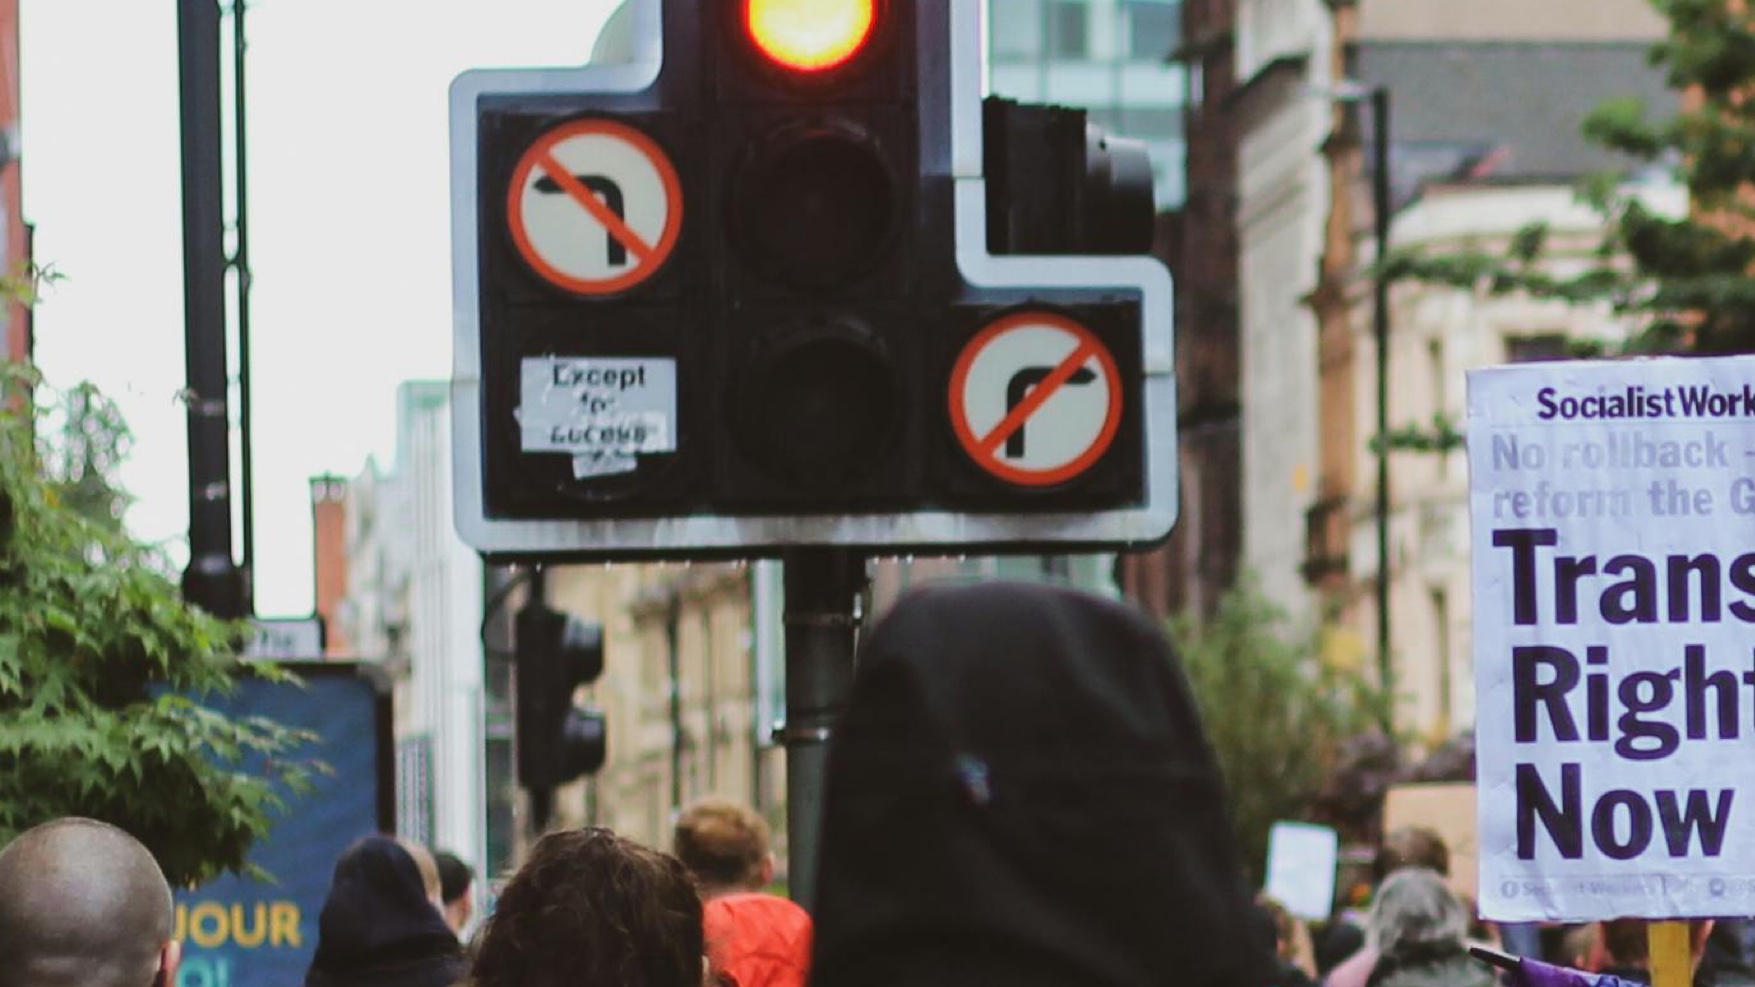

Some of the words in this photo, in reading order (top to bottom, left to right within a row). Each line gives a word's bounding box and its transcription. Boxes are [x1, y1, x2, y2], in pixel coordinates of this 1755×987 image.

[553, 363, 646, 391] Except
[1492, 434, 1545, 471] No
[1561, 431, 1729, 469] rollback
[1492, 480, 1633, 519] reform
[1649, 479, 1714, 519] the
[1514, 762, 1736, 861] Now
